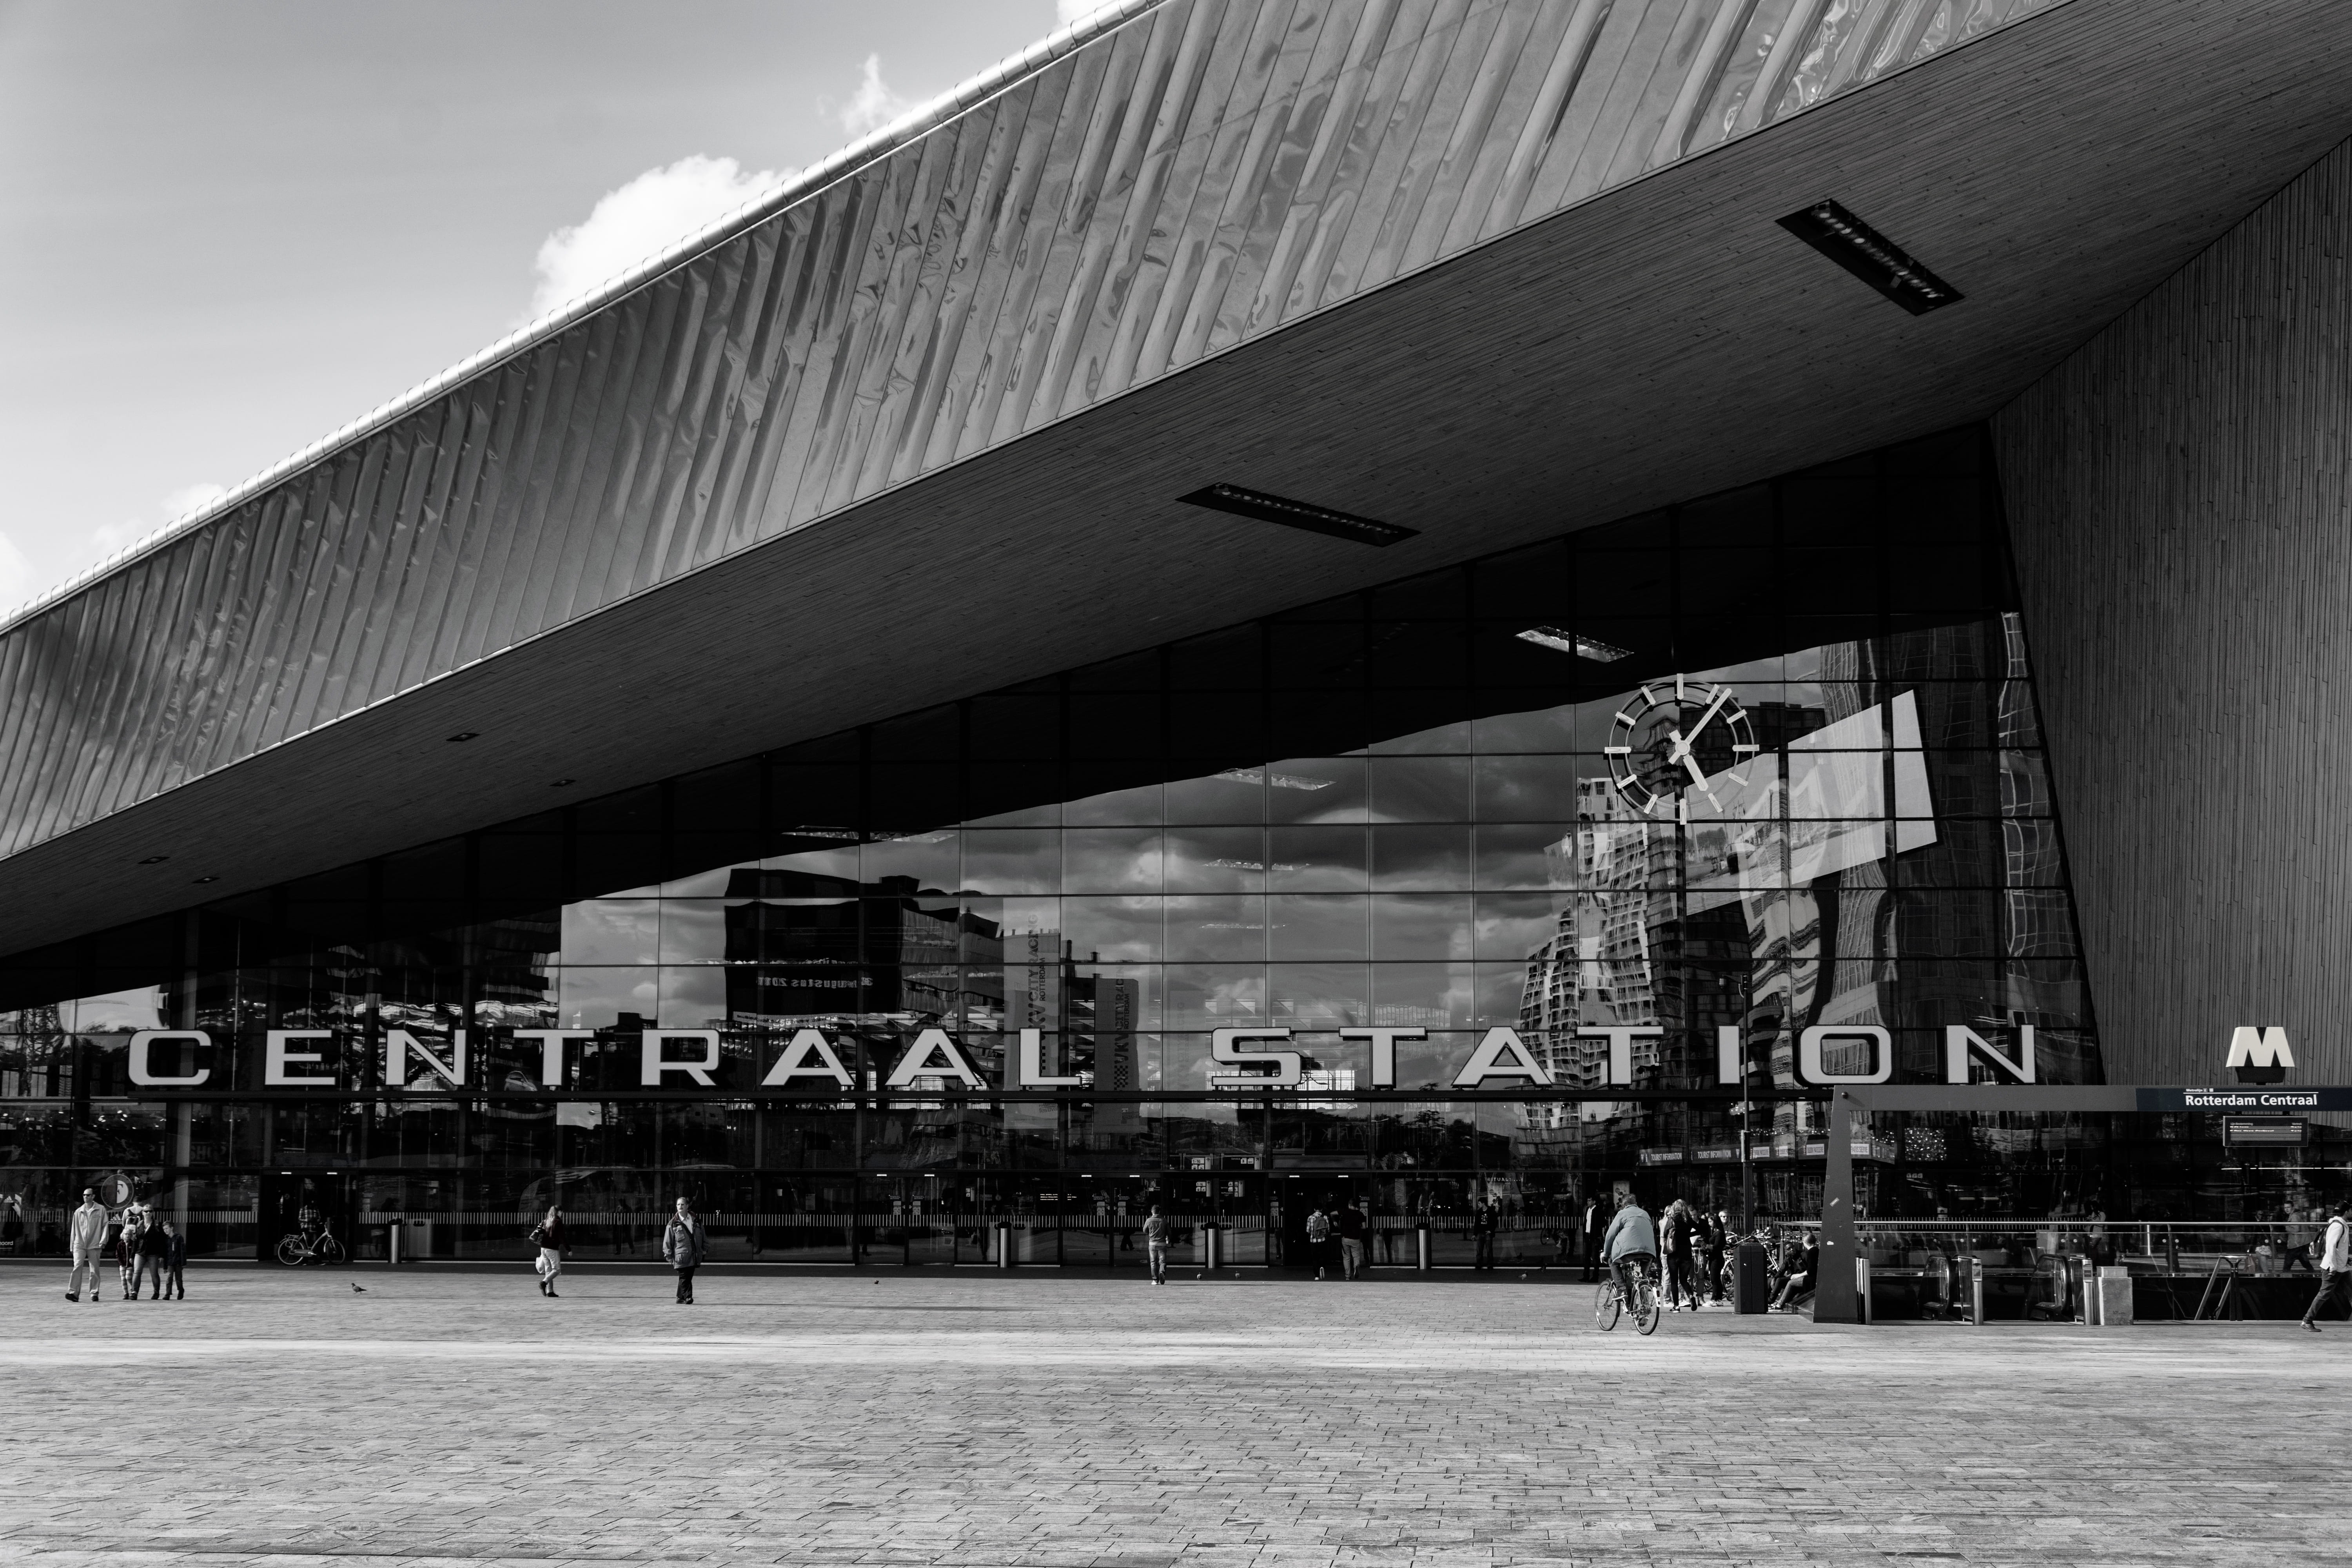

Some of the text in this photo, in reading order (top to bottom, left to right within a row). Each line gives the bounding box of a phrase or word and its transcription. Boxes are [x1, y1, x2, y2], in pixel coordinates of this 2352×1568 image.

[1028, 969, 1039, 1002] CITY
[128, 1027, 1082, 1087] CENTRAAL
[1211, 1024, 2036, 1087] STATION
[2185, 1094, 2318, 1106] Rotterdam Centraal
[1662, 1152, 1682, 1160] INFORMATION
